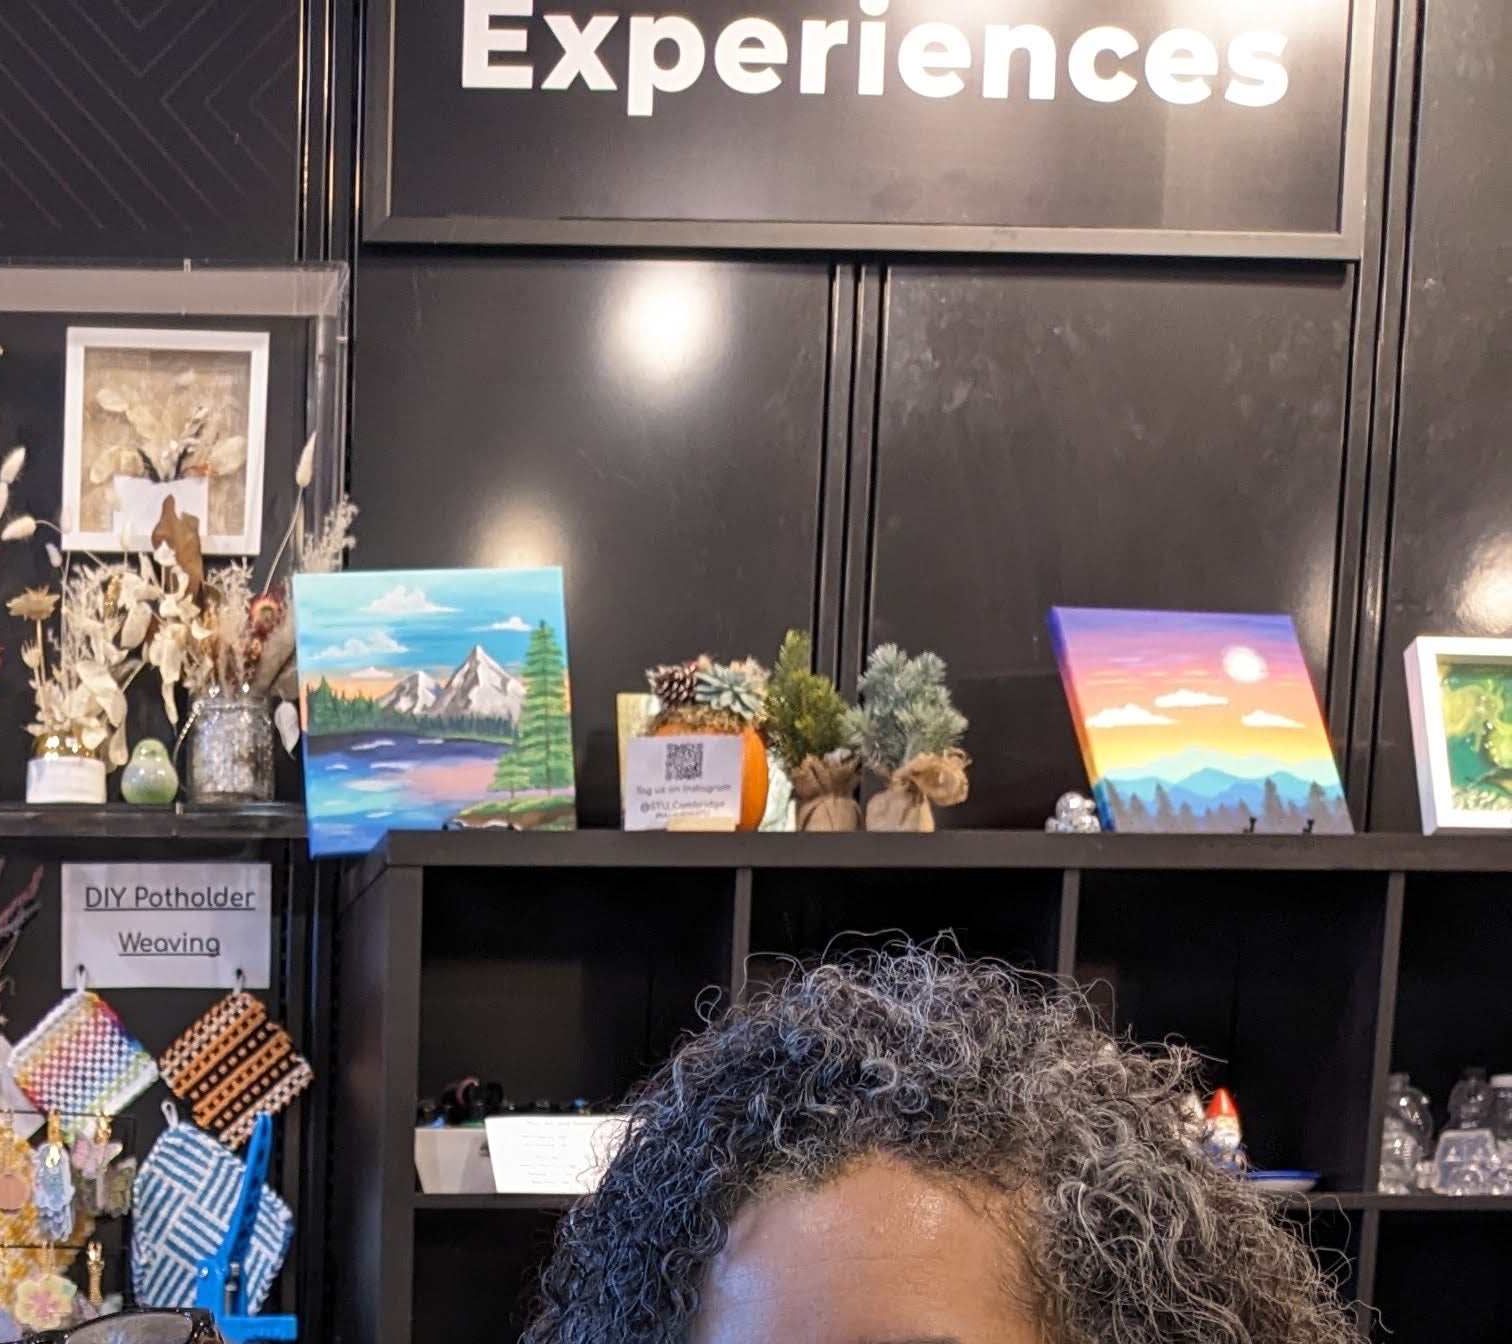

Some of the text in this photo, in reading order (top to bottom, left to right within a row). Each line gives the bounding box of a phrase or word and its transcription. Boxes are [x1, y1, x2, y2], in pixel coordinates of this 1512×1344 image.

[462, 0, 1289, 117] Experiences
[85, 885, 256, 908] DIY Potholder
[118, 932, 221, 957] Weaving
